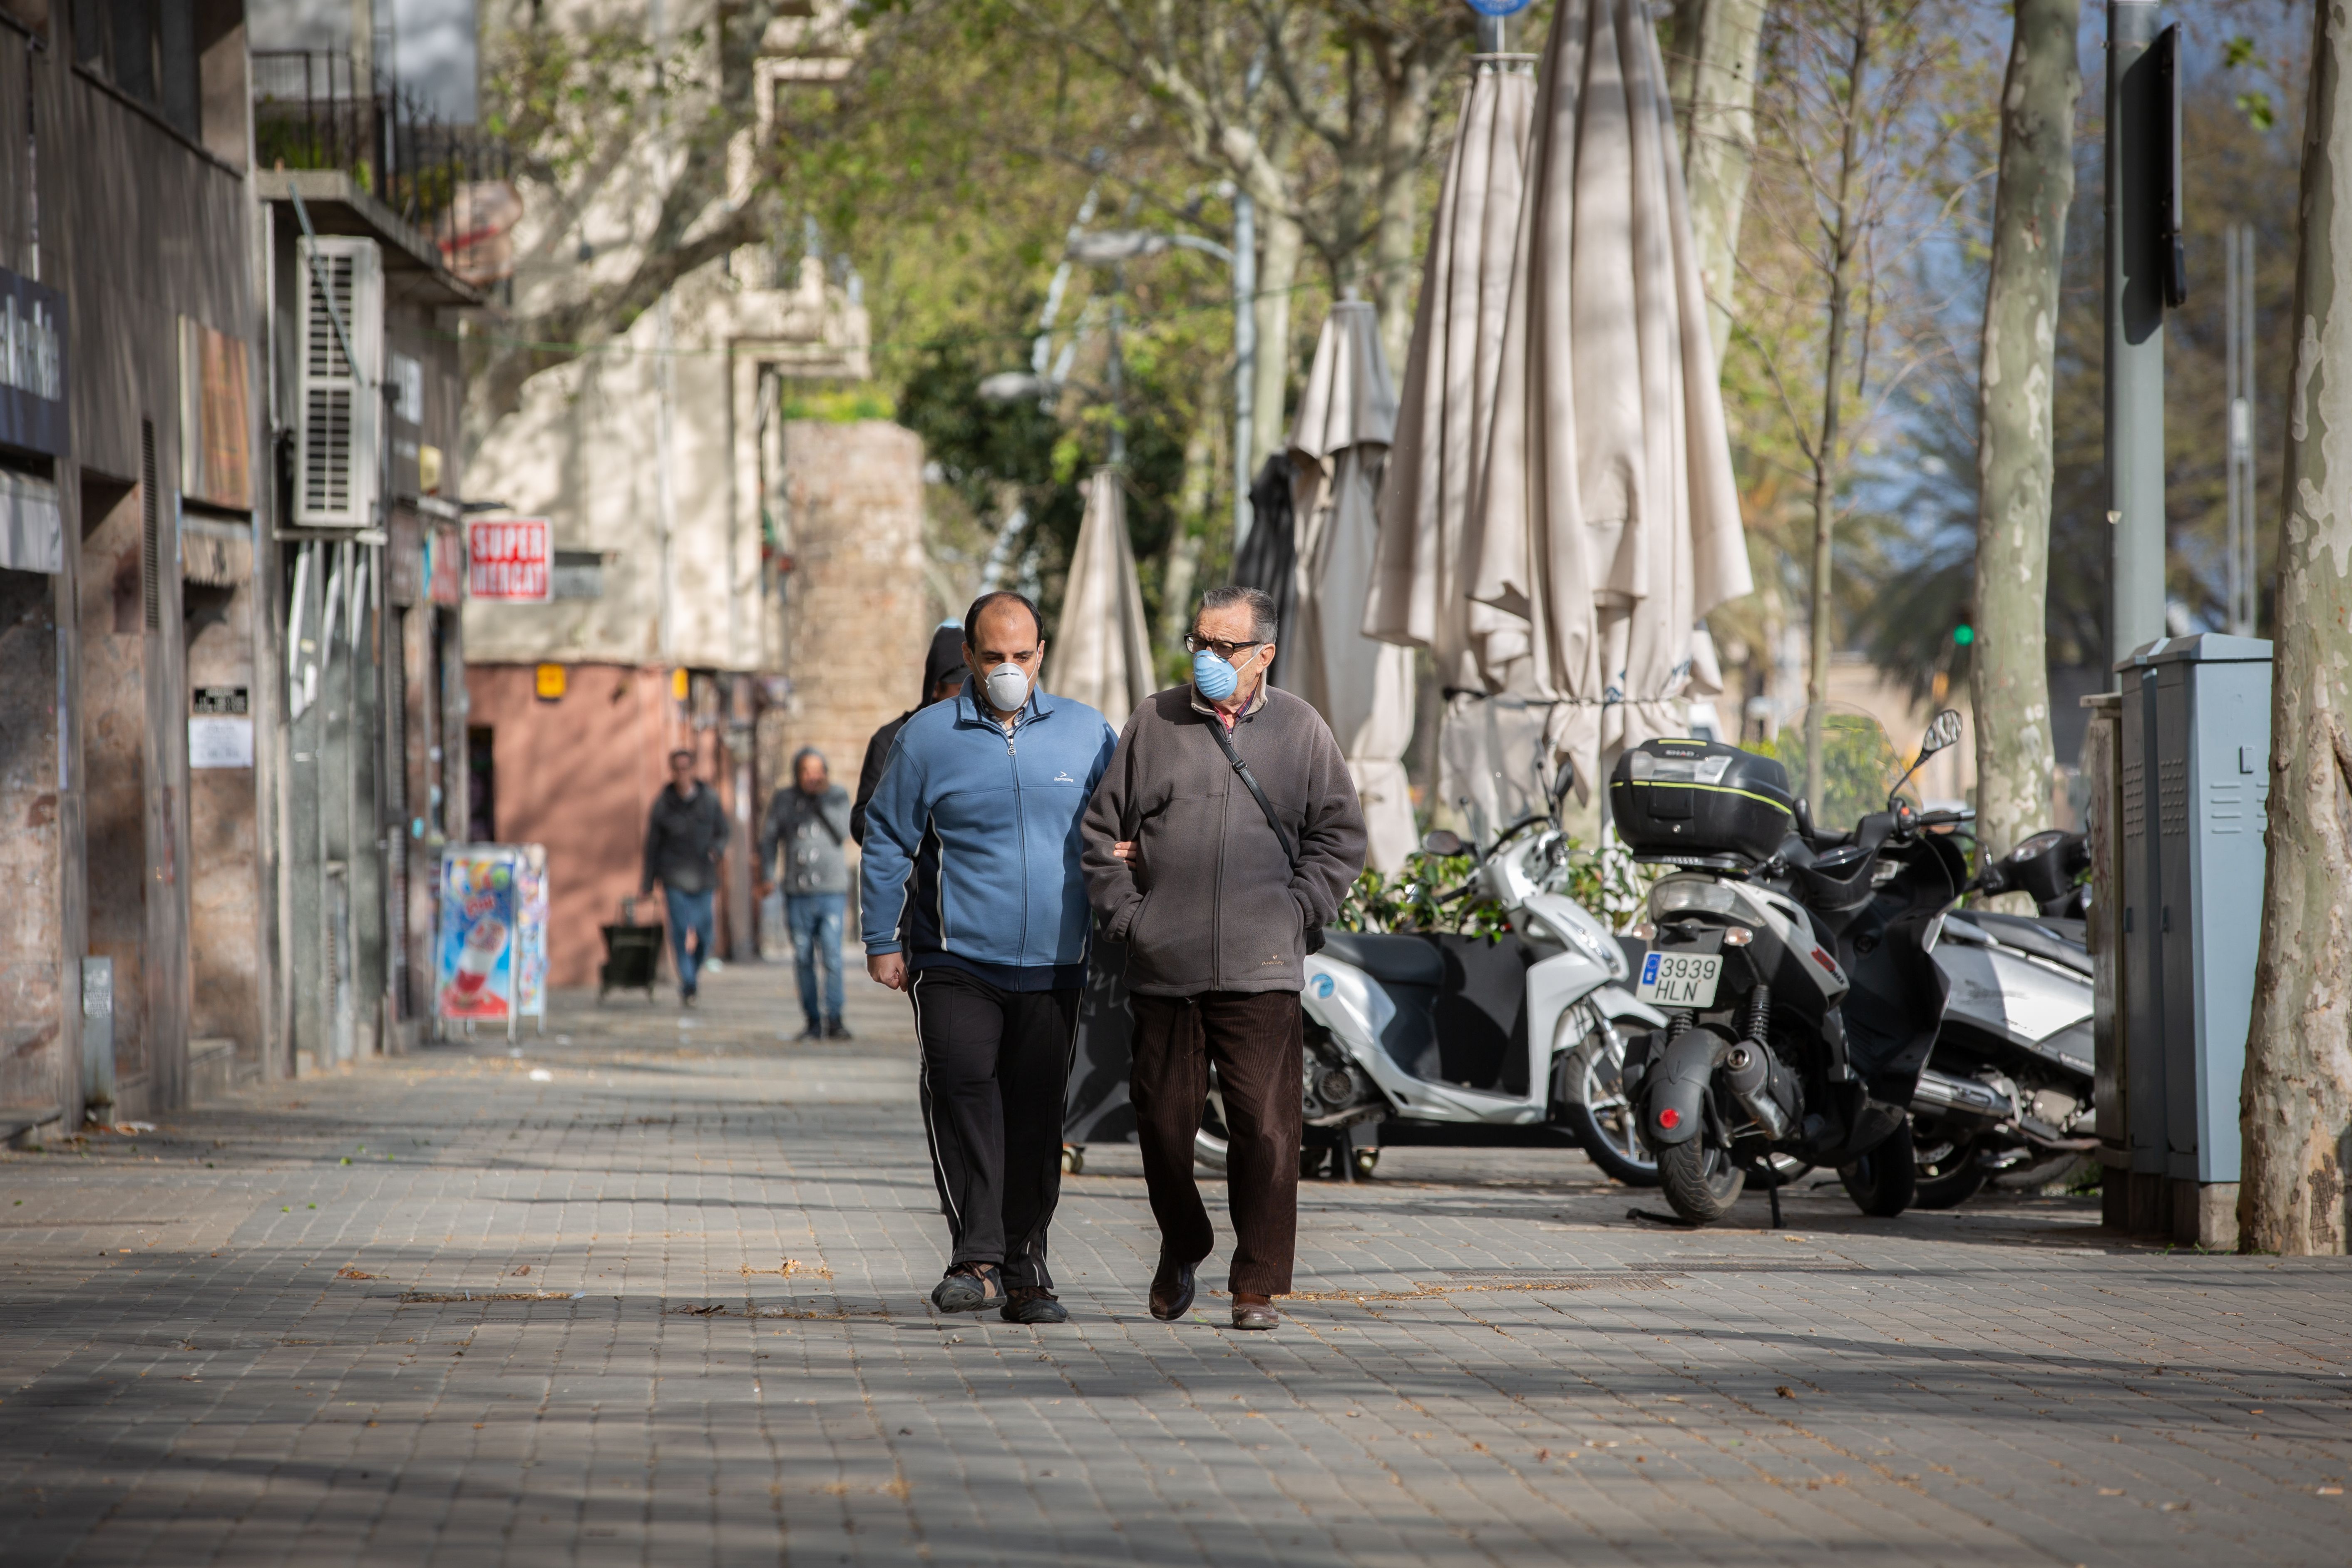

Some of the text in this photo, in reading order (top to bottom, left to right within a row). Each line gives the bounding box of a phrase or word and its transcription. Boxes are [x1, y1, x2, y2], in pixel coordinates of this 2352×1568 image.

[475, 526, 542, 558] SUPER
[473, 563, 544, 593] MERCAT
[1646, 972, 1654, 981] E
[1661, 958, 1716, 980] 3939
[1655, 979, 1698, 1002] HLN
